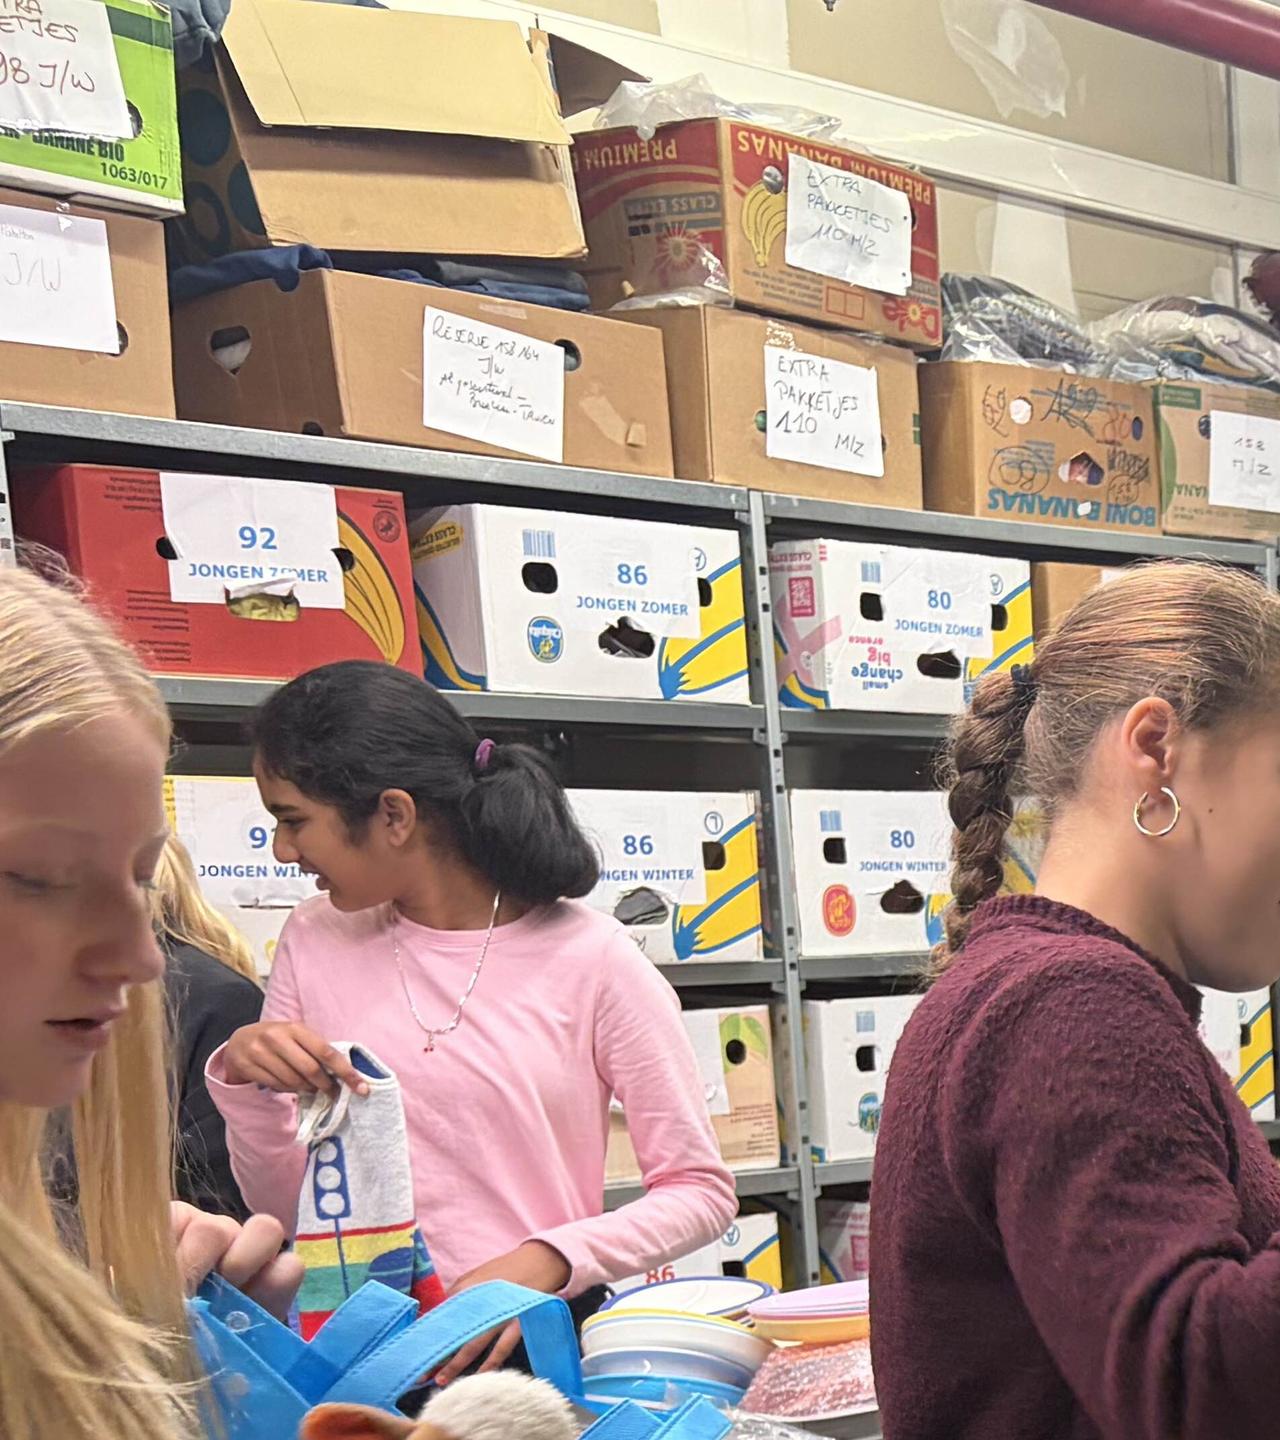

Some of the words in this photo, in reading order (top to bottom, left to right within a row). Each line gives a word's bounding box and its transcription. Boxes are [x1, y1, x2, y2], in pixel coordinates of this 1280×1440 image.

[99, 138, 125, 162] BIO
[583, 139, 678, 171] PREMIUM
[100, 162, 169, 190] 1063/017
[808, 169, 861, 195] EXTRA
[778, 355, 830, 382] EXTRA
[775, 410, 818, 435] 110
[1104, 502, 1157, 528] BONI
[239, 526, 277, 550] 92
[189, 563, 264, 580] JONGEN
[617, 564, 648, 586] 86
[576, 595, 637, 613] JONGEN
[641, 600, 689, 616] ZOMER
[928, 590, 951, 610] 80
[895, 619, 942, 634] JONGEN
[945, 621, 984, 638] ZOMER
[867, 647, 892, 667] big
[851, 663, 904, 682] change
[862, 680, 889, 690] small
[250, 827, 276, 849] 9
[623, 835, 654, 856] 86
[890, 830, 915, 849] 80
[198, 865, 268, 878] JONGEN
[273, 865, 310, 878] WIN
[600, 868, 638, 882] NGEN
[642, 868, 695, 882] WINTER
[860, 860, 904, 873] JONGEN
[906, 861, 948, 873] WINTER
[646, 1264, 676, 1284] 86
